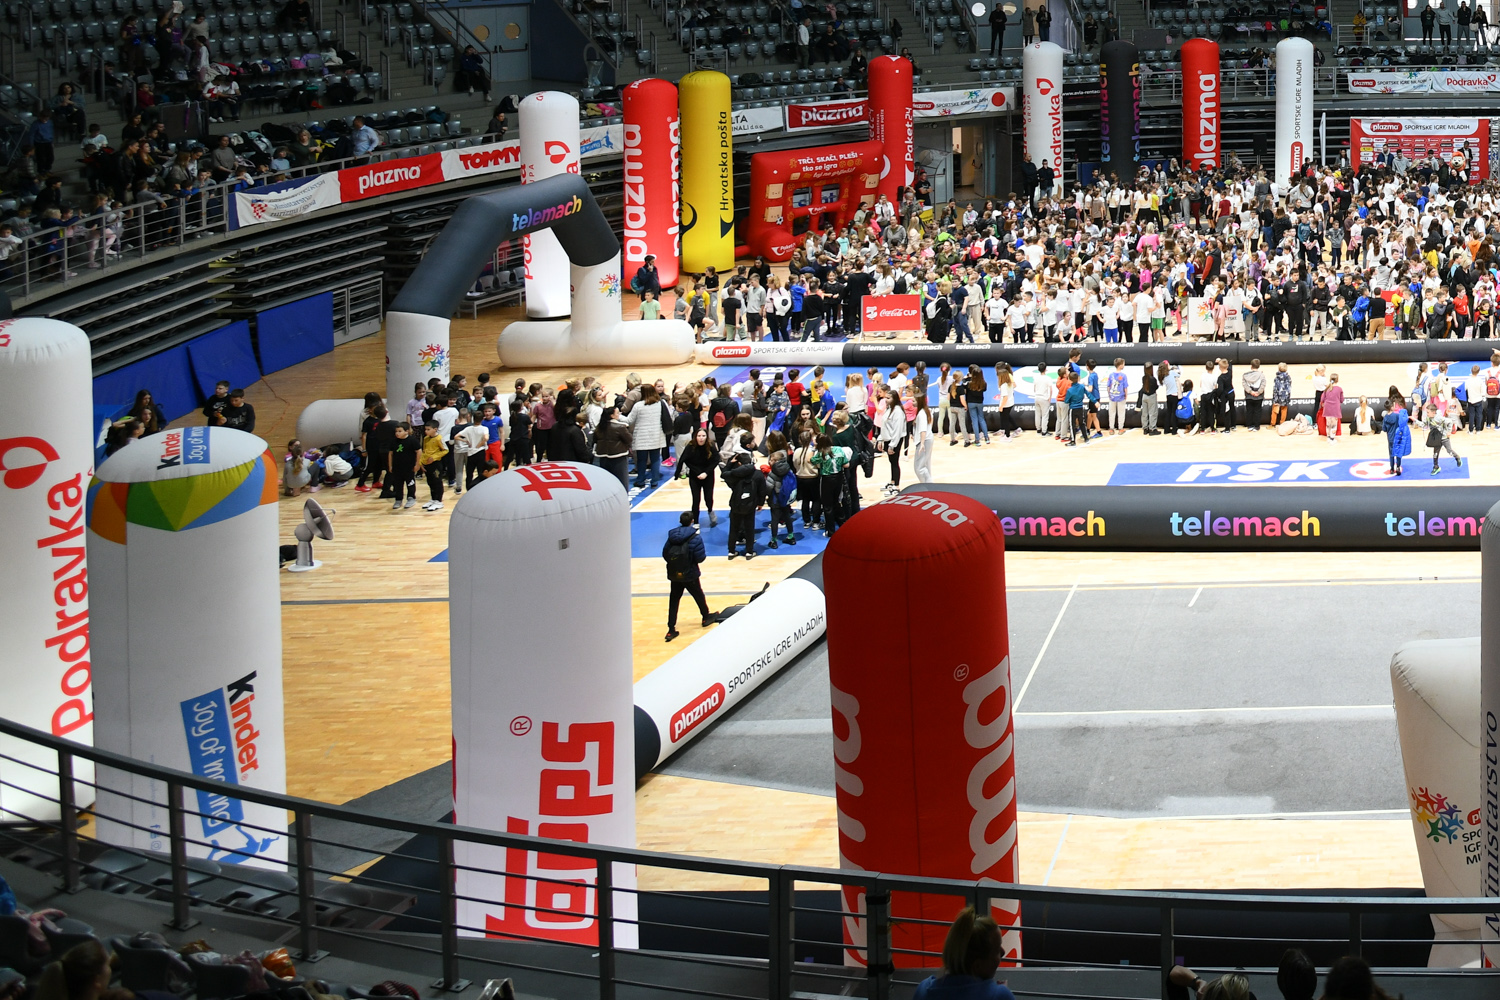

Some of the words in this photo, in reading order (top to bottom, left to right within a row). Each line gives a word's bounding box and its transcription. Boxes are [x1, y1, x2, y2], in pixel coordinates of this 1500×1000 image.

[1446, 77, 1488, 86] Podravka
[717, 111, 727, 148] pošta
[800, 105, 865, 125] plazma
[1372, 123, 1400, 131] plazma
[905, 107, 913, 161] Paket24
[458, 144, 521, 171] TOMMY
[358, 164, 421, 194] plazma
[624, 124, 648, 262] plazma
[718, 151, 729, 212] Hrvatska
[511, 194, 583, 232] telemach
[879, 308, 903, 318] Coca-Cola
[903, 309, 918, 317] CUP
[715, 347, 748, 357] plazma
[753, 345, 788, 354] SPORTSKE
[788, 345, 804, 353] IGRE
[805, 345, 834, 353] MLADIH
[157, 431, 181, 471] Kinder
[189, 444, 206, 461] Joy
[1175, 461, 1340, 482] PSK
[1001, 510, 1106, 537] emach
[1169, 510, 1321, 538] telemach
[673, 690, 720, 741] plazma
[727, 649, 773, 695] SPORTSKE
[773, 637, 793, 660] IGRE
[793, 610, 825, 643] MLADIH
[191, 700, 218, 739] Joy
[227, 669, 260, 774] Kinder
[200, 736, 226, 757] of
